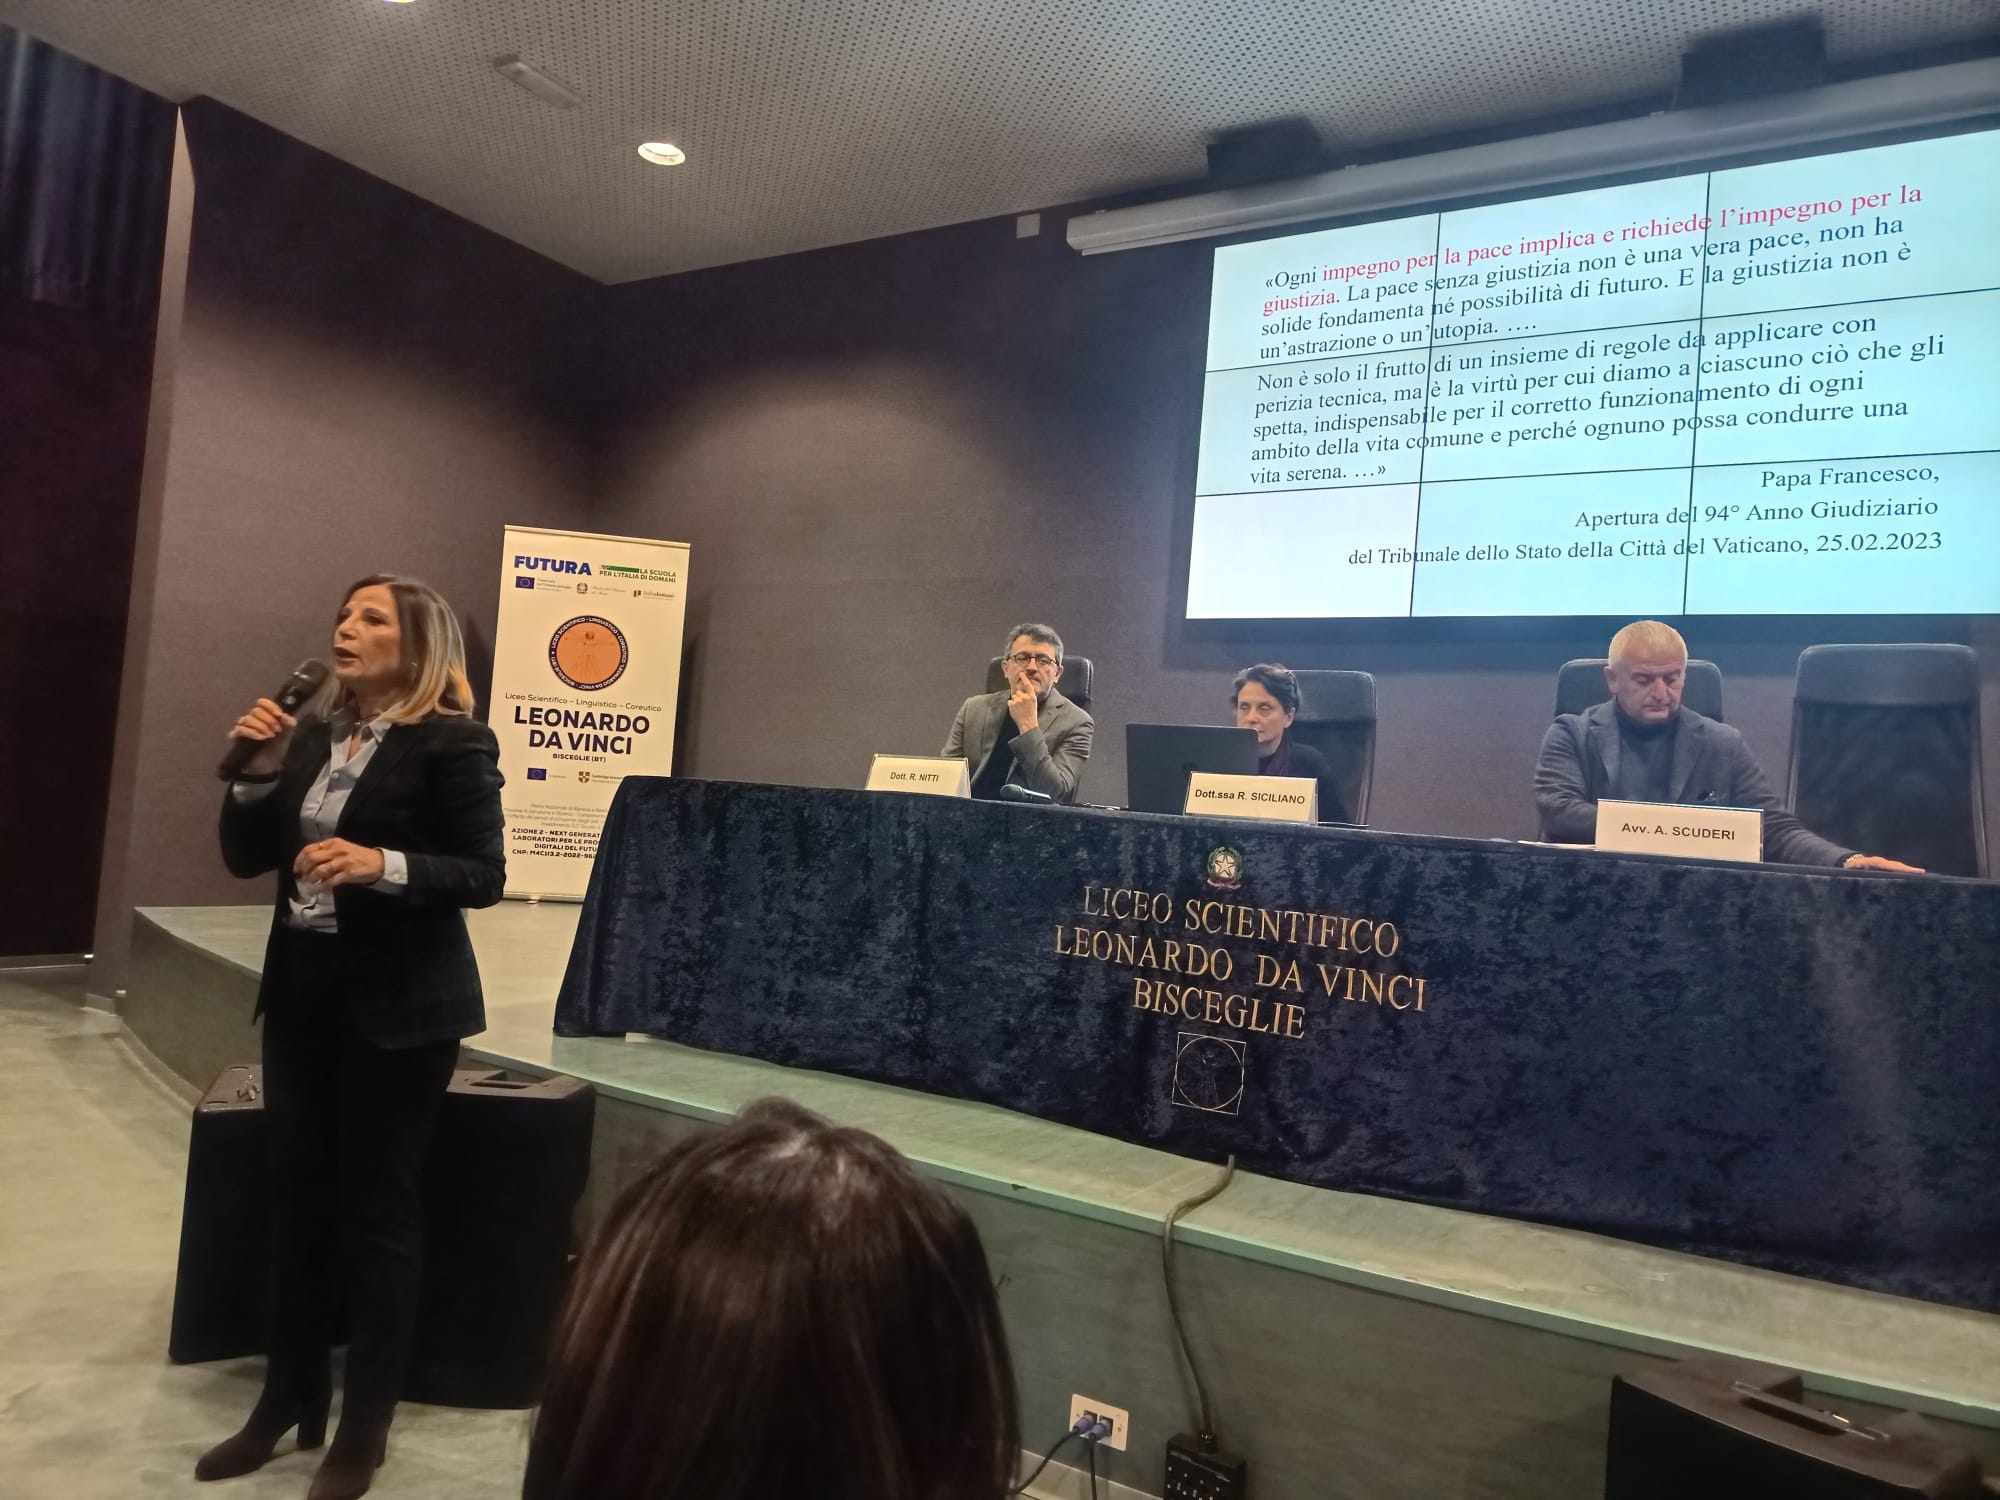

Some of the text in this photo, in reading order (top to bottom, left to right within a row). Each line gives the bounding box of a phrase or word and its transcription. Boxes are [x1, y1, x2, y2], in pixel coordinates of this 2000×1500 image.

[1265, 267, 1317, 290] «Ogni
[1323, 259, 1400, 282] impegno
[1407, 254, 1437, 275] per
[1445, 248, 1461, 265] la
[1468, 244, 1512, 266] pace
[1520, 231, 1595, 257] implica
[1603, 229, 1614, 242] e
[1622, 213, 1712, 241] richiede
[1852, 194, 1891, 216] per
[1901, 185, 1922, 203] la
[1263, 217, 1904, 316] giustizia. La pace senza giustizia non è una vera pace, non ha
[1261, 243, 1911, 336] solide fondamenta né possibilità di futuro. E la giustizia non è
[1258, 318, 1876, 391] Non è solo il frutto di un insieme di regole da applicare con
[1382, 333, 1393, 345] o
[1255, 334, 1945, 418] perizia tecnica, ma è la virtù per cui diamo a ciascuno ciò che gli
[1253, 371, 1864, 439] spetta, indispensabile per il corretto funzionamento di ogni
[1251, 401, 1908, 461] ambito della vita comune e perché ognuno possa condurre una
[1250, 466, 1281, 484] vita
[1286, 464, 1347, 481] serena.
[1761, 467, 1939, 491] Papa Francesco,
[1574, 498, 1938, 531] Apertura del 94° Anno Giudiziario
[1349, 532, 1942, 564] del Tribunale dello Stato della Città del Vaticano, 25.02.2023
[514, 556, 592, 575] FUTURA
[506, 693, 661, 711] Liceo Scientifico Linguistico Coreutico
[514, 706, 649, 734] LEONARDO
[529, 730, 632, 754] DA VINCI
[890, 772, 907, 780] Dott.
[919, 774, 939, 782] NITTI
[1195, 789, 1305, 804] Dott.ssa R. SICILIANO
[513, 835, 558, 843] LABORATORI
[1621, 823, 1735, 840] Avv. A. SCUDERI
[1083, 886, 1399, 958] LICEO SCIENTIFICO
[1055, 924, 1428, 1012] LEONARDO DA VINCI
[1133, 977, 1306, 1039] BISCEGLIE
